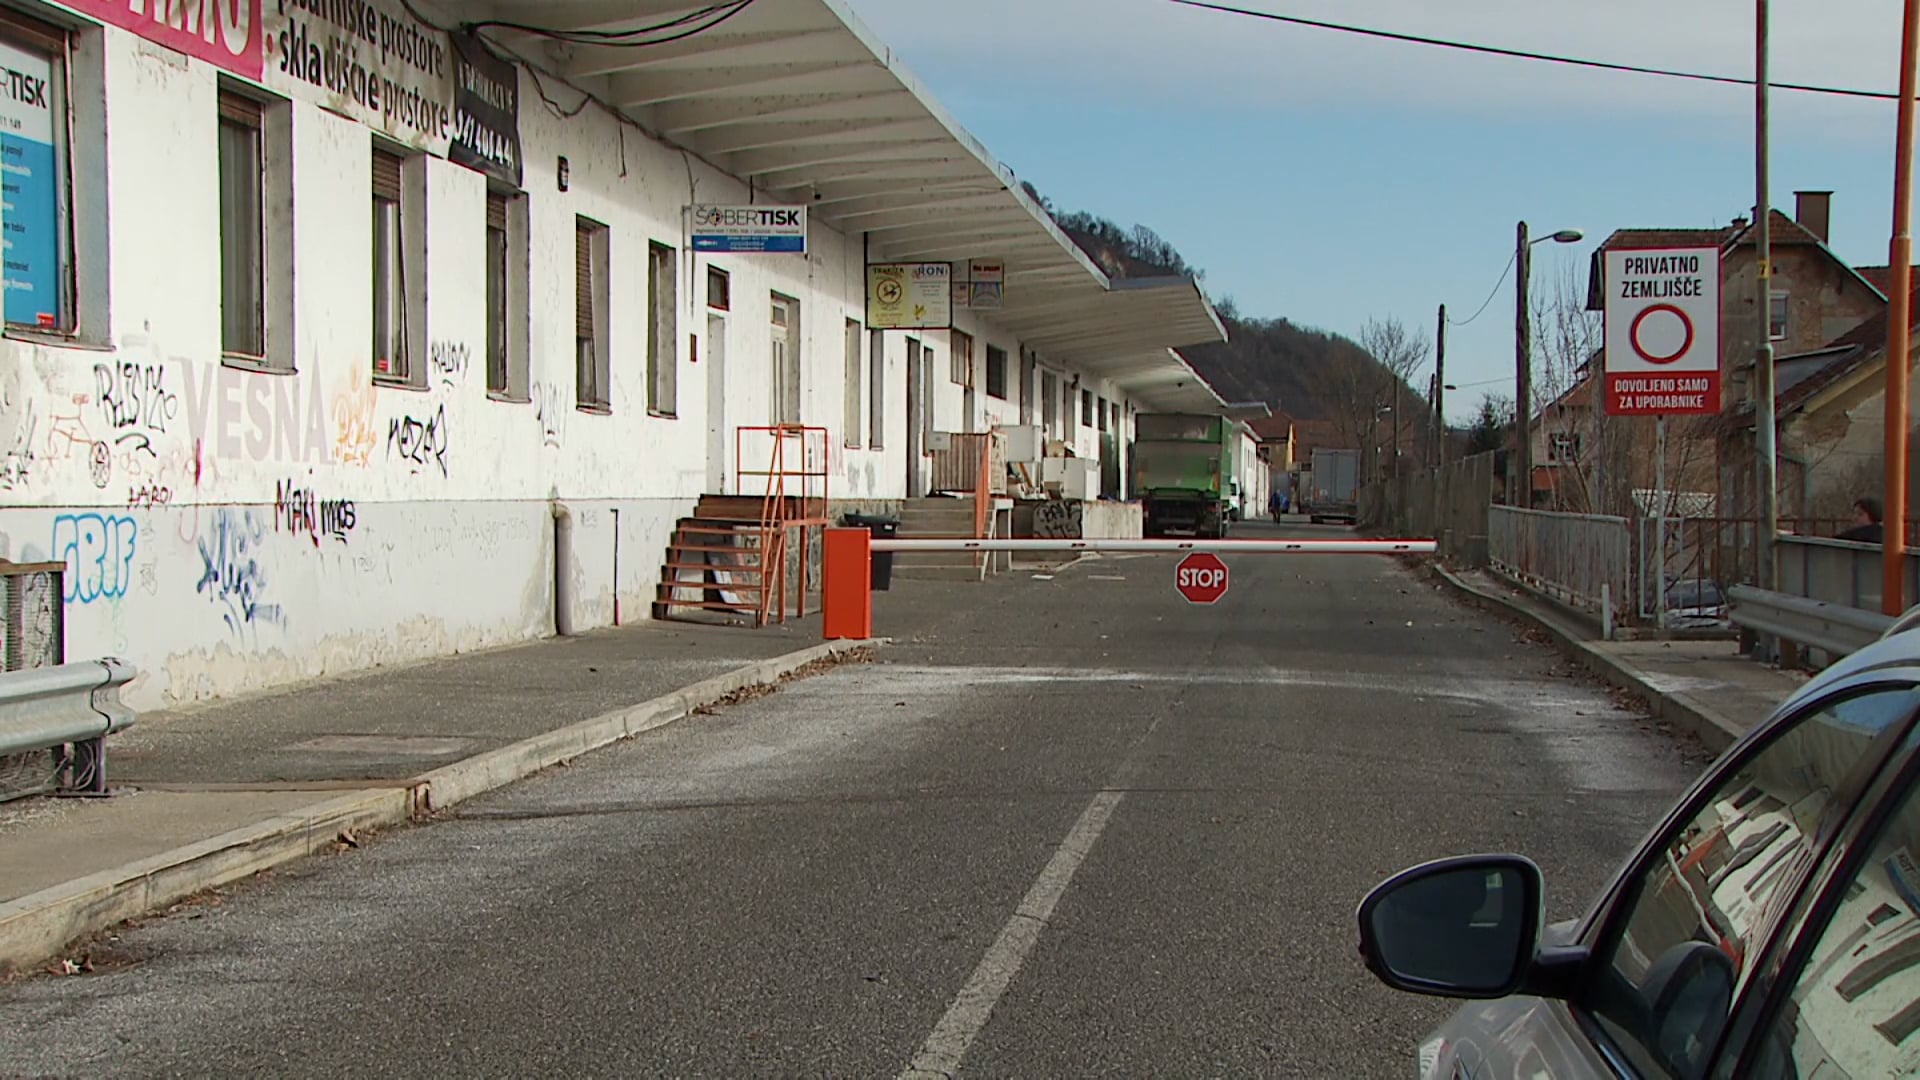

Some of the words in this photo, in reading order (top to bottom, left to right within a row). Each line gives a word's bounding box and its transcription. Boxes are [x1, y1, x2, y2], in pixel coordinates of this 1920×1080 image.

[380, 12, 444, 79] prostore
[383, 78, 450, 140] prostore
[1624, 256, 1699, 275] PRIVATNO
[1621, 277, 1702, 298] ZEMLJIŠČE
[1615, 379, 1675, 393] DOVOLJENO
[1677, 378, 1709, 391] SAMO
[168, 340, 336, 465] VESNA
[1619, 396, 1633, 409] ZA
[1636, 394, 1704, 409] UPORABNIKE
[1179, 568, 1225, 588] STOP
